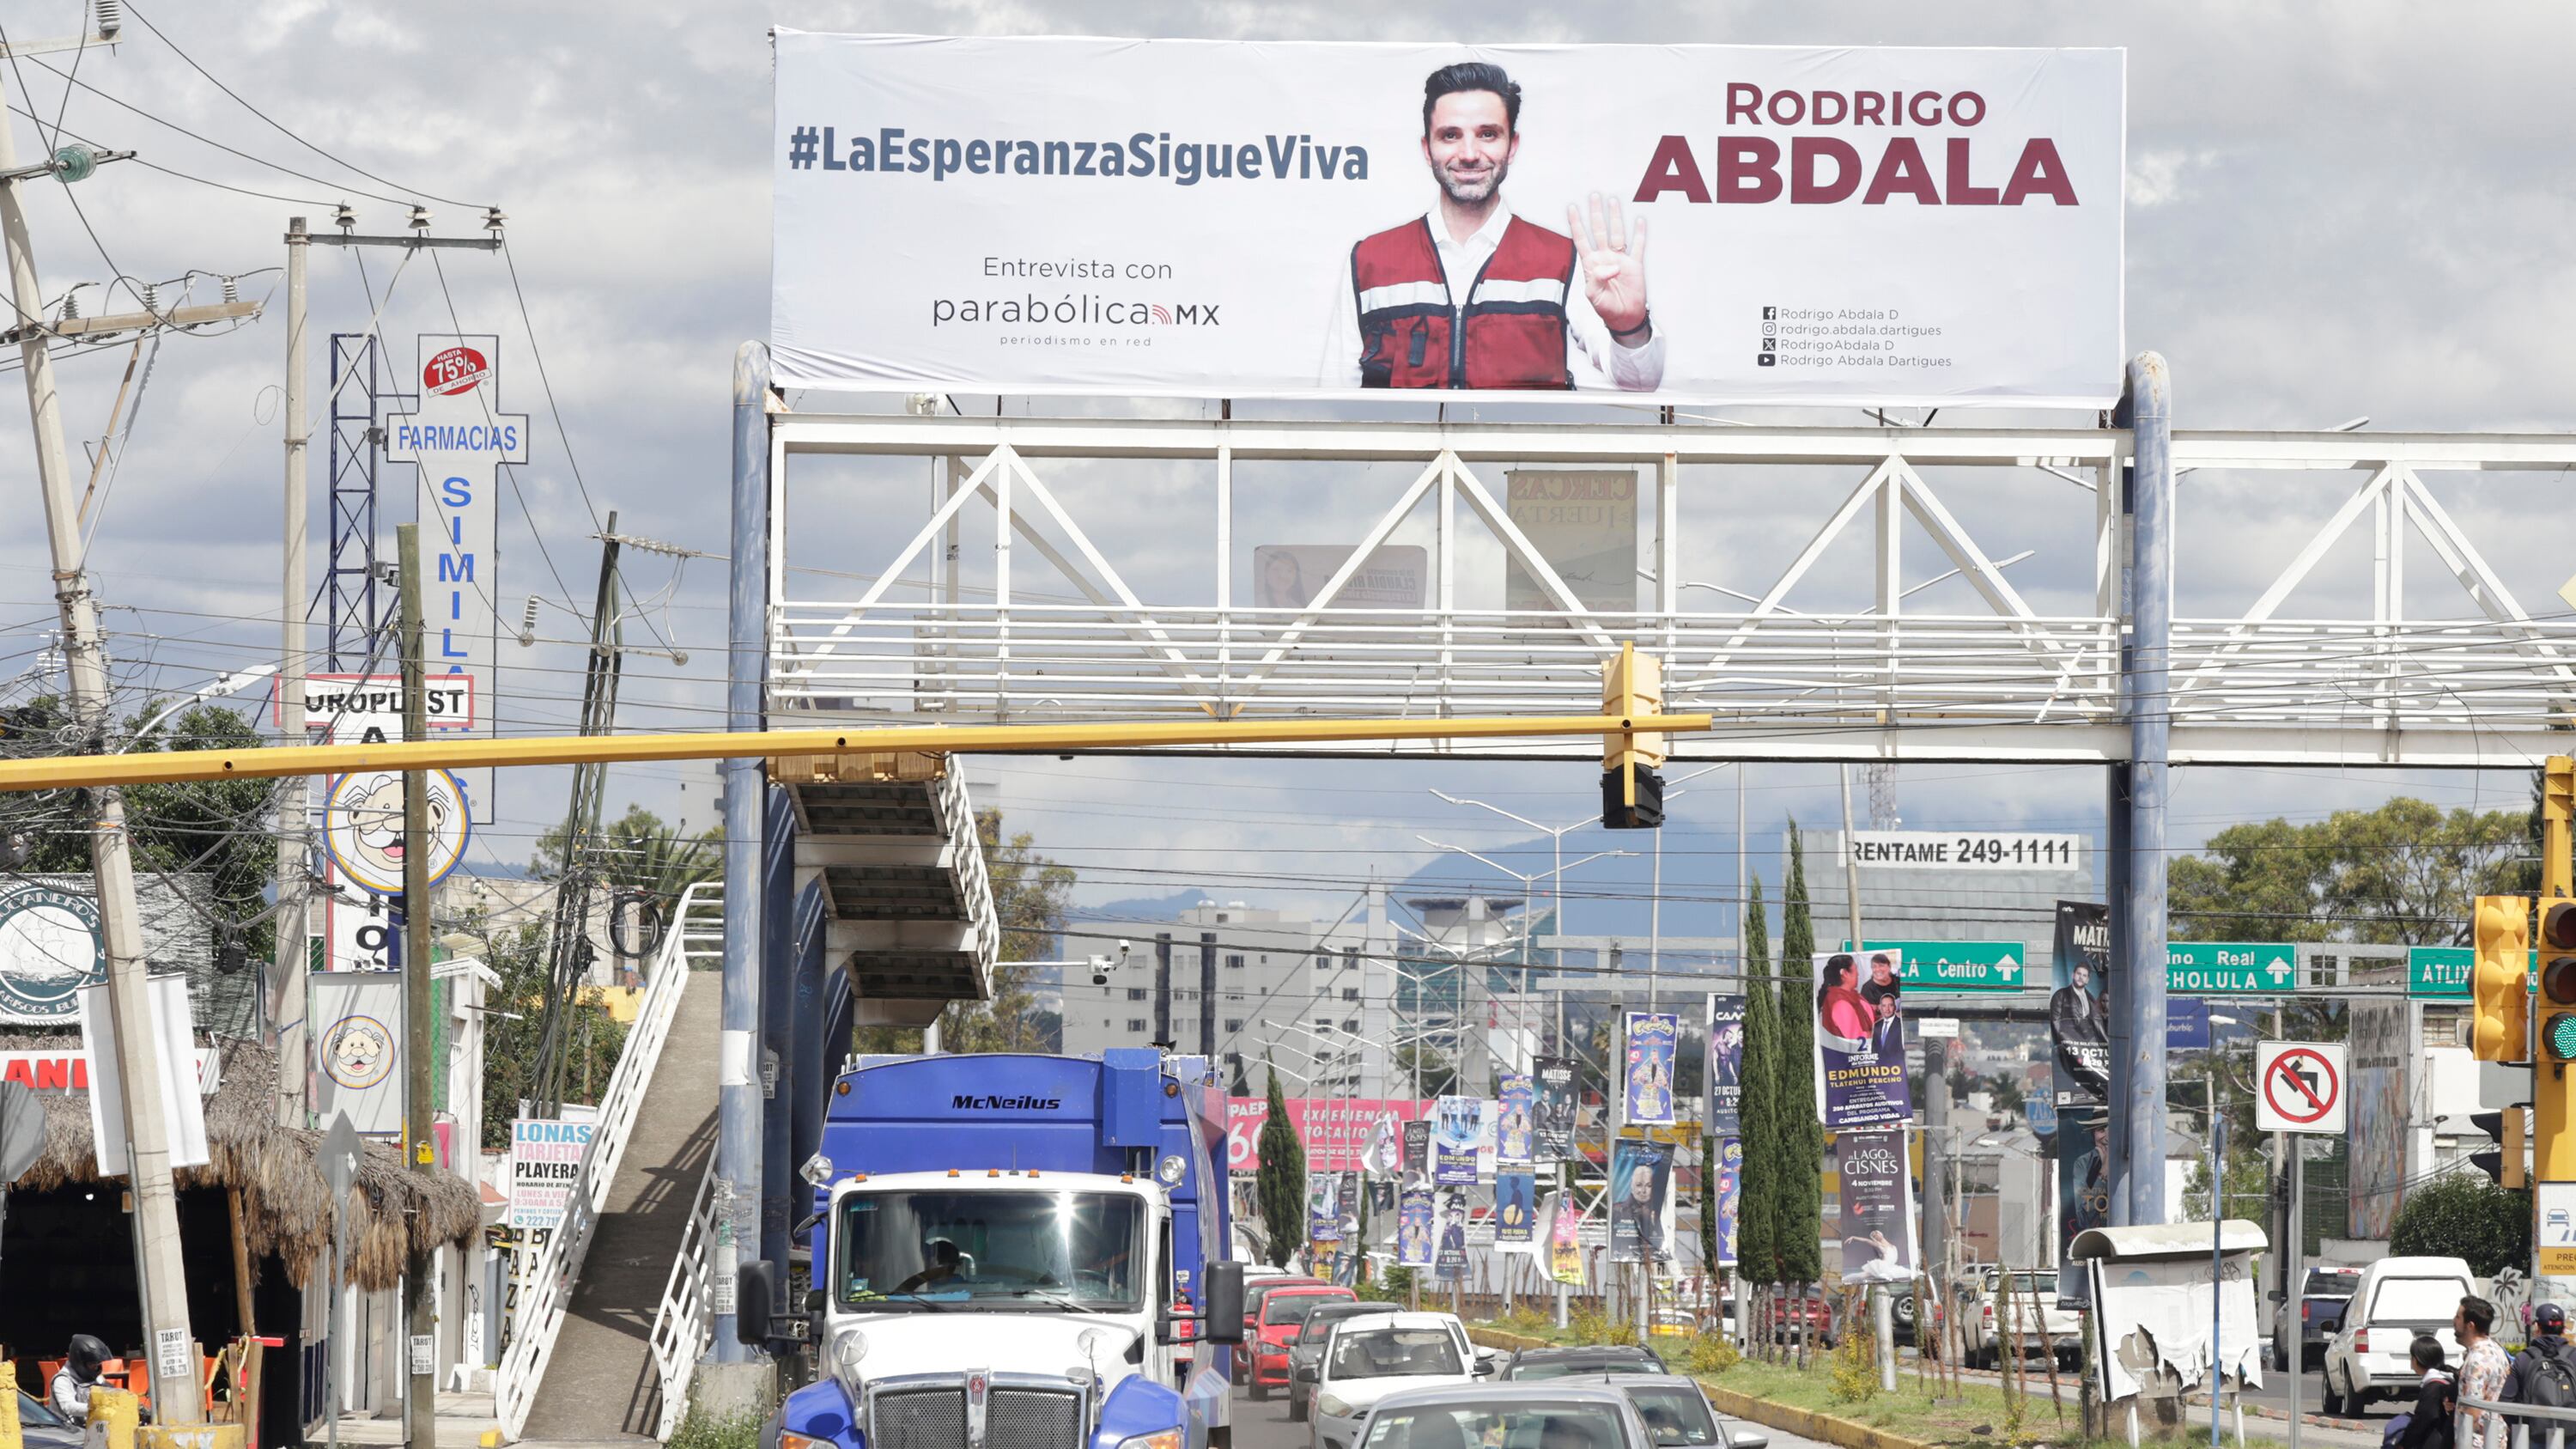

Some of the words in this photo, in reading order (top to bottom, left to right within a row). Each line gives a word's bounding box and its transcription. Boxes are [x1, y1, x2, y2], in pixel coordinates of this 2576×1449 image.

[1726, 82, 1987, 127] RODRIGO
[789, 125, 1370, 186] #LaEsperanzaSigueViva
[1632, 135, 2080, 206] ABDALA
[984, 257, 1115, 279] Entrevista
[1126, 263, 1172, 279] con
[933, 293, 1149, 327] parabólica
[1176, 304, 1220, 326] MX
[1781, 308, 1834, 321] Rodrigo
[1838, 309, 1885, 320] Abdala
[1889, 309, 1899, 320] D
[1781, 324, 1942, 338] rodrigo.abdala.dartigues
[1000, 335, 1091, 346] periodismo
[1100, 337, 1117, 346] en
[1126, 336, 1151, 346] red
[1781, 338, 1880, 351] RodrigoAbdala
[1885, 340, 1894, 350] D
[437, 349, 462, 362] HASTA
[1781, 355, 1833, 367] Rodrigo
[1838, 355, 1884, 366] Abdala
[1888, 356, 1952, 368] Dartigues
[432, 356, 477, 384] 75%
[433, 386, 445, 394] DE
[398, 425, 517, 451] FARMACIAS
[1854, 841, 1947, 862] RENTAME
[1957, 838, 2070, 864] 249-1111
[0, 892, 100, 928] UCANERO'S
[2074, 925, 2110, 947] MATI
[2217, 950, 2255, 965] Real
[1936, 957, 1987, 978] Centro
[2421, 964, 2472, 984] ATLIX
[2166, 971, 2258, 989] HOLULA
[0, 989, 50, 1014] ARISCOS
[2066, 1046, 2079, 1056] 13
[1541, 1068, 1572, 1081] MATISSE
[1828, 1065, 1901, 1081] EDMUNDO
[952, 1095, 1061, 1110] McNeilus
[1303, 1110, 1400, 1123] EXPERIENCA
[517, 1123, 592, 1143] LONAS
[1854, 1148, 1888, 1160] LAGO
[515, 1162, 580, 1179] PLAYERA
[1844, 1160, 1899, 1175] CISNES
[2081, 1195, 2109, 1213] TO
[526, 1215, 546, 1227] 222
[161, 1331, 183, 1342] TAROT
[413, 1337, 433, 1347] TAROT
